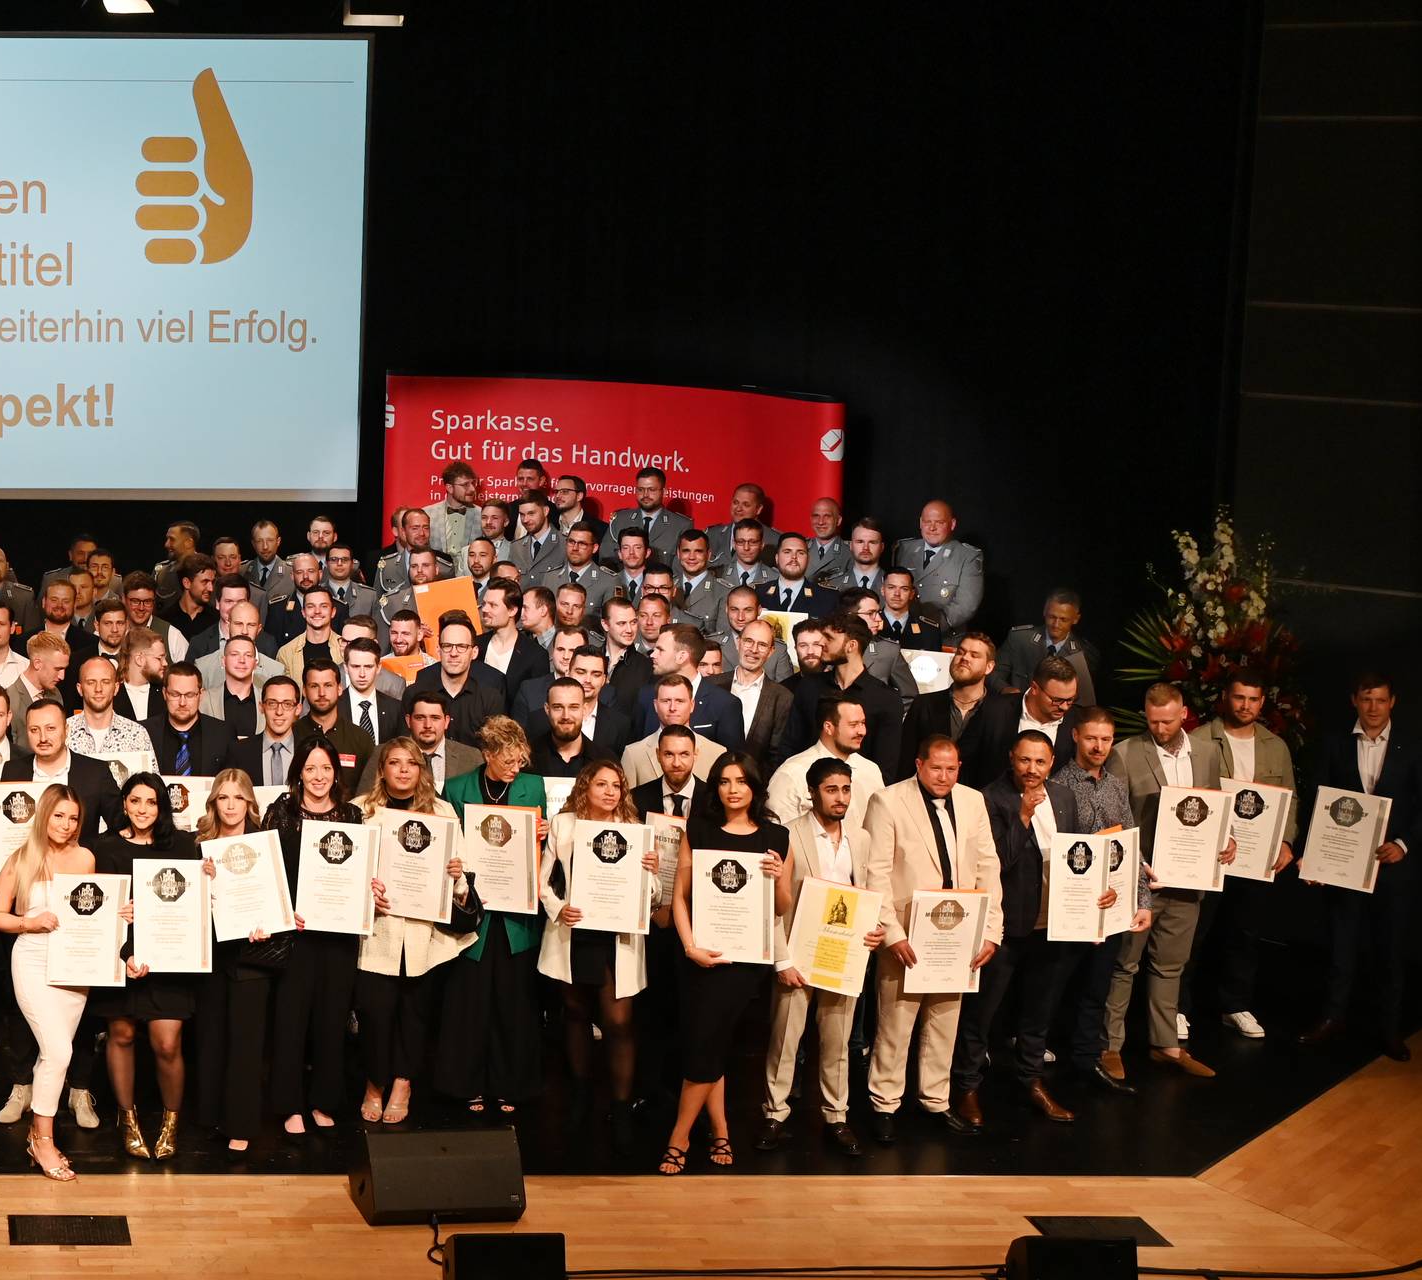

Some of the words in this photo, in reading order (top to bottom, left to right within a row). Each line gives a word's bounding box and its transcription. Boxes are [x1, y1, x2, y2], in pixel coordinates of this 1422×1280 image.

[138, 311, 194, 343] viel
[209, 310, 318, 354] Erfolg.
[431, 409, 560, 434] Sparkasse.
[431, 440, 472, 460] Gut
[482, 439, 516, 461] für
[521, 441, 563, 463] das
[572, 444, 690, 473] Handwerk.
[430, 489, 441, 501] in
[664, 487, 715, 503] eistungen
